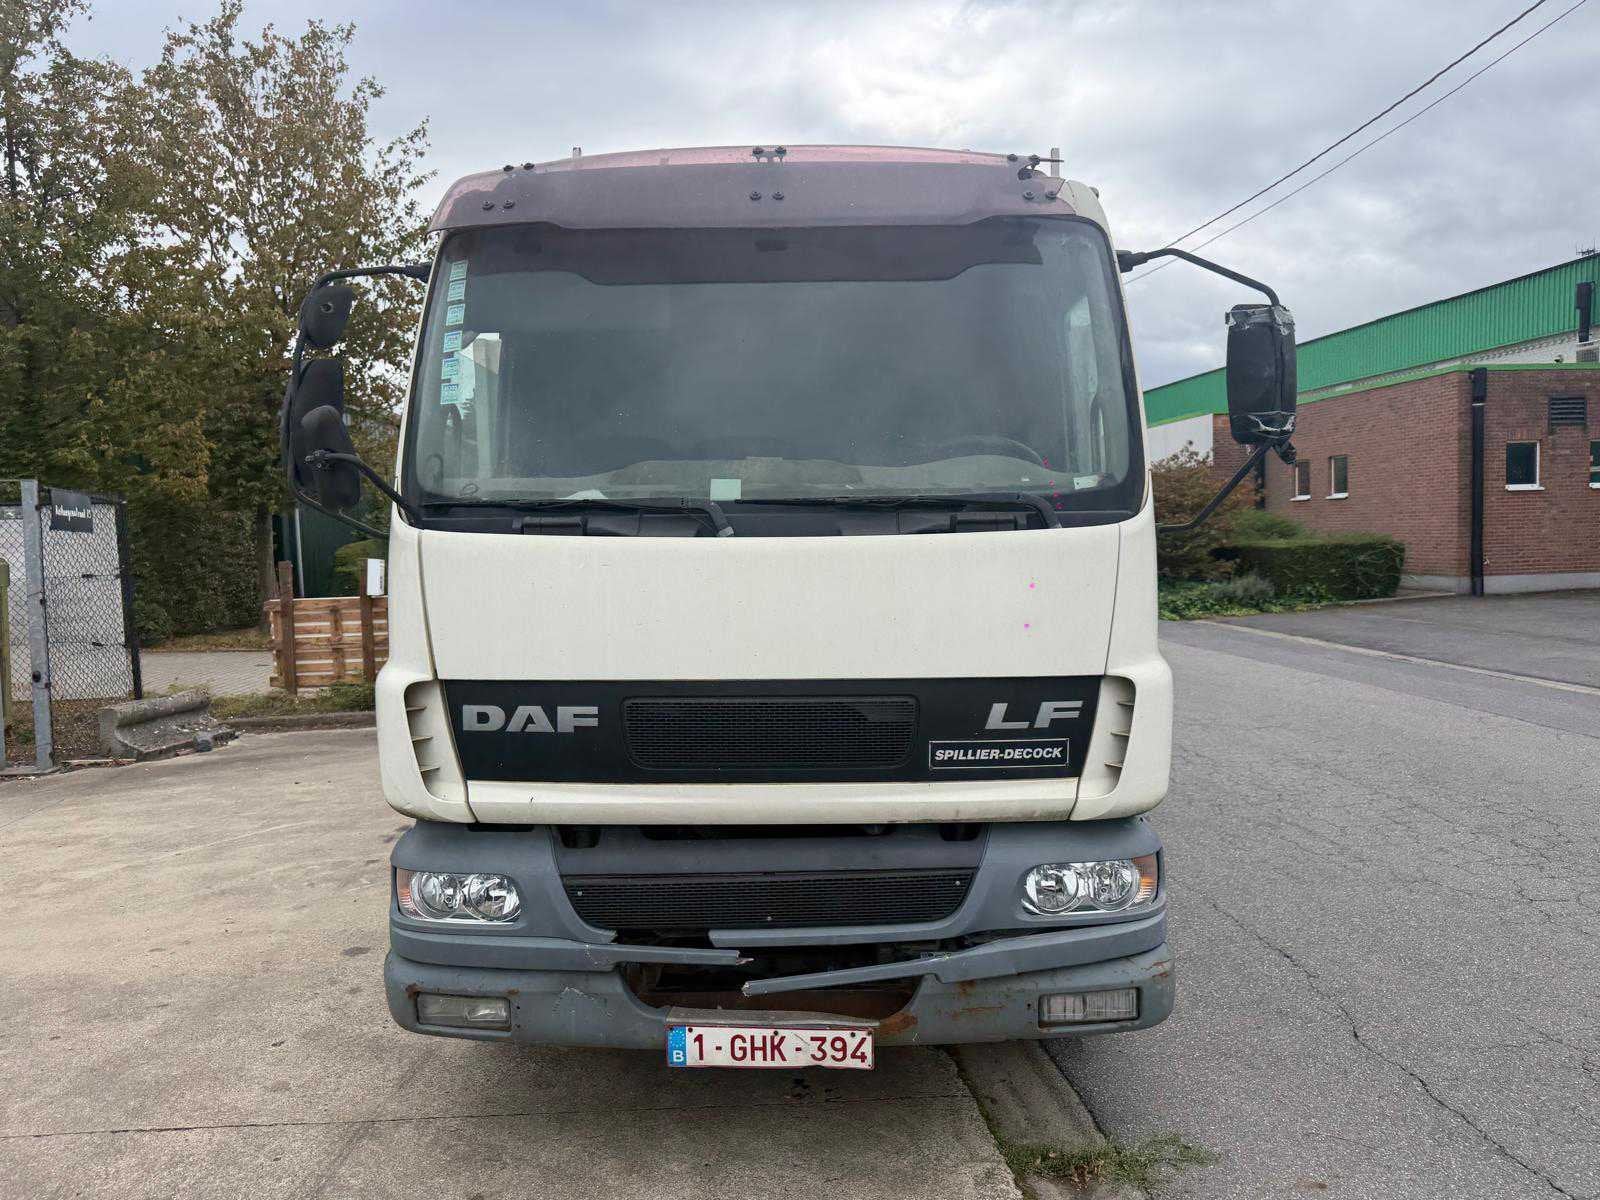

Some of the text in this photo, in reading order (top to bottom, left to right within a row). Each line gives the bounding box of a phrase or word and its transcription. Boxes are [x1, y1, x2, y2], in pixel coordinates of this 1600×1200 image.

[462, 704, 599, 733] DAF
[984, 700, 1084, 730] LF
[934, 746, 1063, 761] SPILLIER-DECOCK
[672, 1050, 685, 1063] B
